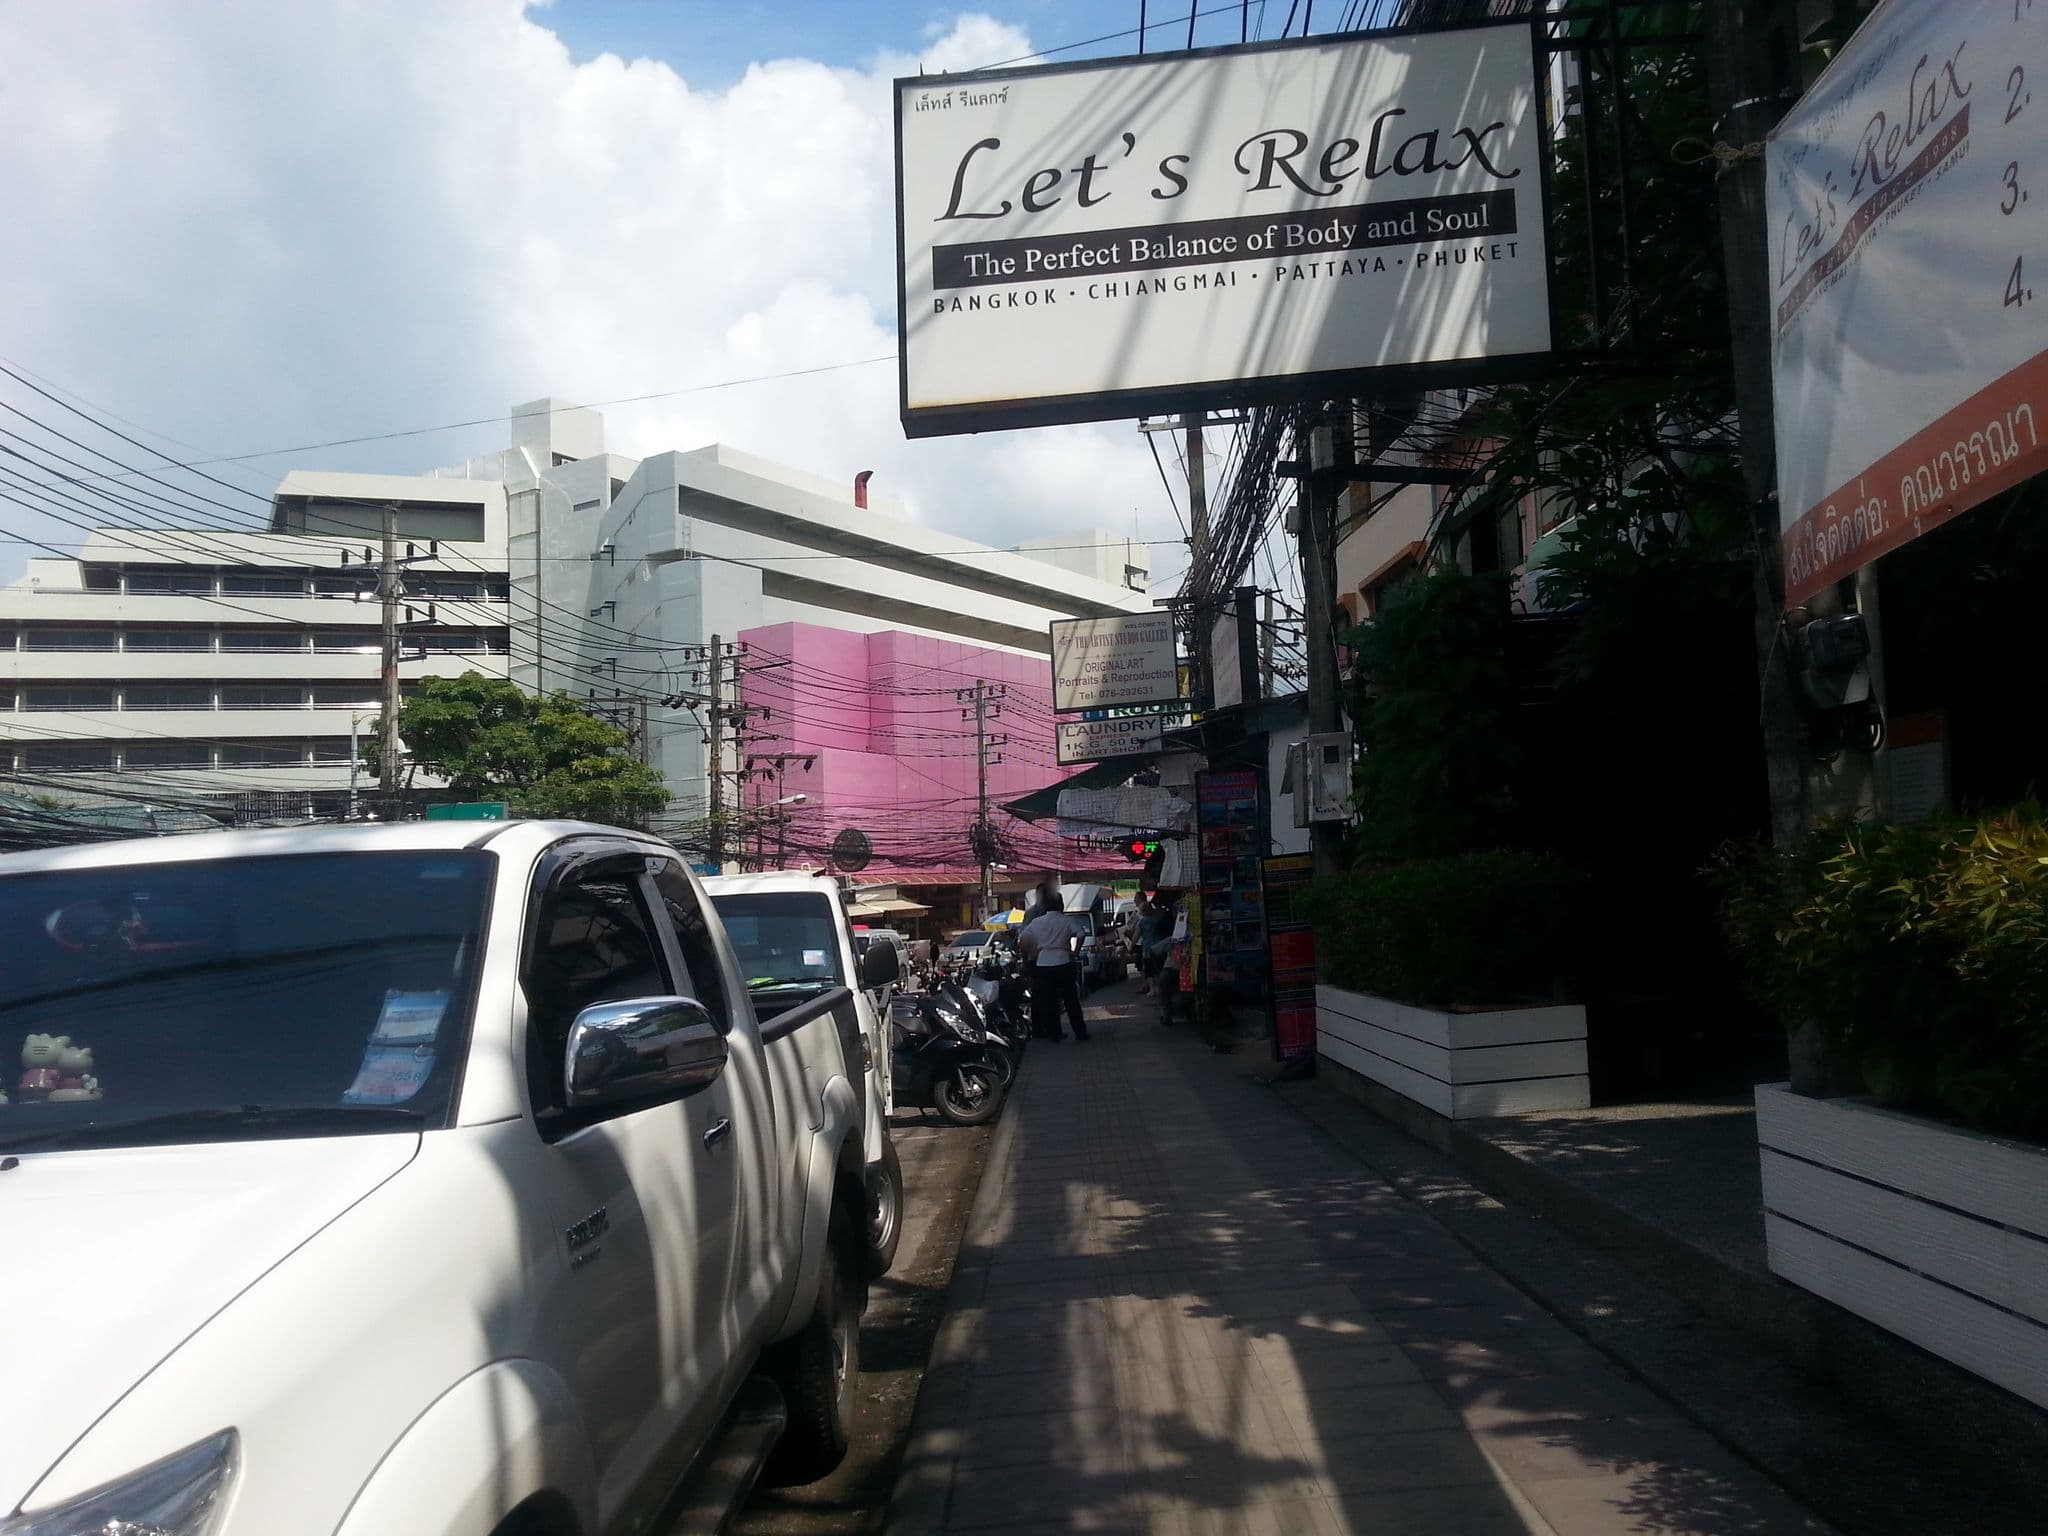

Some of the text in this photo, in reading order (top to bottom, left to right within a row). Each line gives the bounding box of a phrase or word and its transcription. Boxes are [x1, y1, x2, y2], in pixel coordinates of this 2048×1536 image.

[915, 86, 1009, 112] เล็ทส์ รีแลกซ์
[2004, 64, 2031, 125] 2.
[934, 108, 1520, 222] Let's Relax
[1779, 40, 1973, 288] Let's Relax
[1863, 169, 1915, 226] since
[1923, 123, 1959, 170] 1998
[2000, 160, 2029, 216] 3.
[964, 204, 1490, 278] The Perfect Balance of Body and Soul
[933, 242, 1519, 314] BANGKOK CHIANGMAI PATTAYA PHUKET
[2003, 255, 2032, 308] 4.
[1901, 403, 2037, 537] คุณวรรณา
[1075, 629, 1168, 649] THE ARTIST STUDIO GALLERY
[1085, 658, 1144, 673] ORIGINAL ART
[1059, 669, 1174, 688] Portraits & Reproduction
[1065, 719, 1156, 737] LAUNDRY
[1087, 748, 1107, 756] ART
